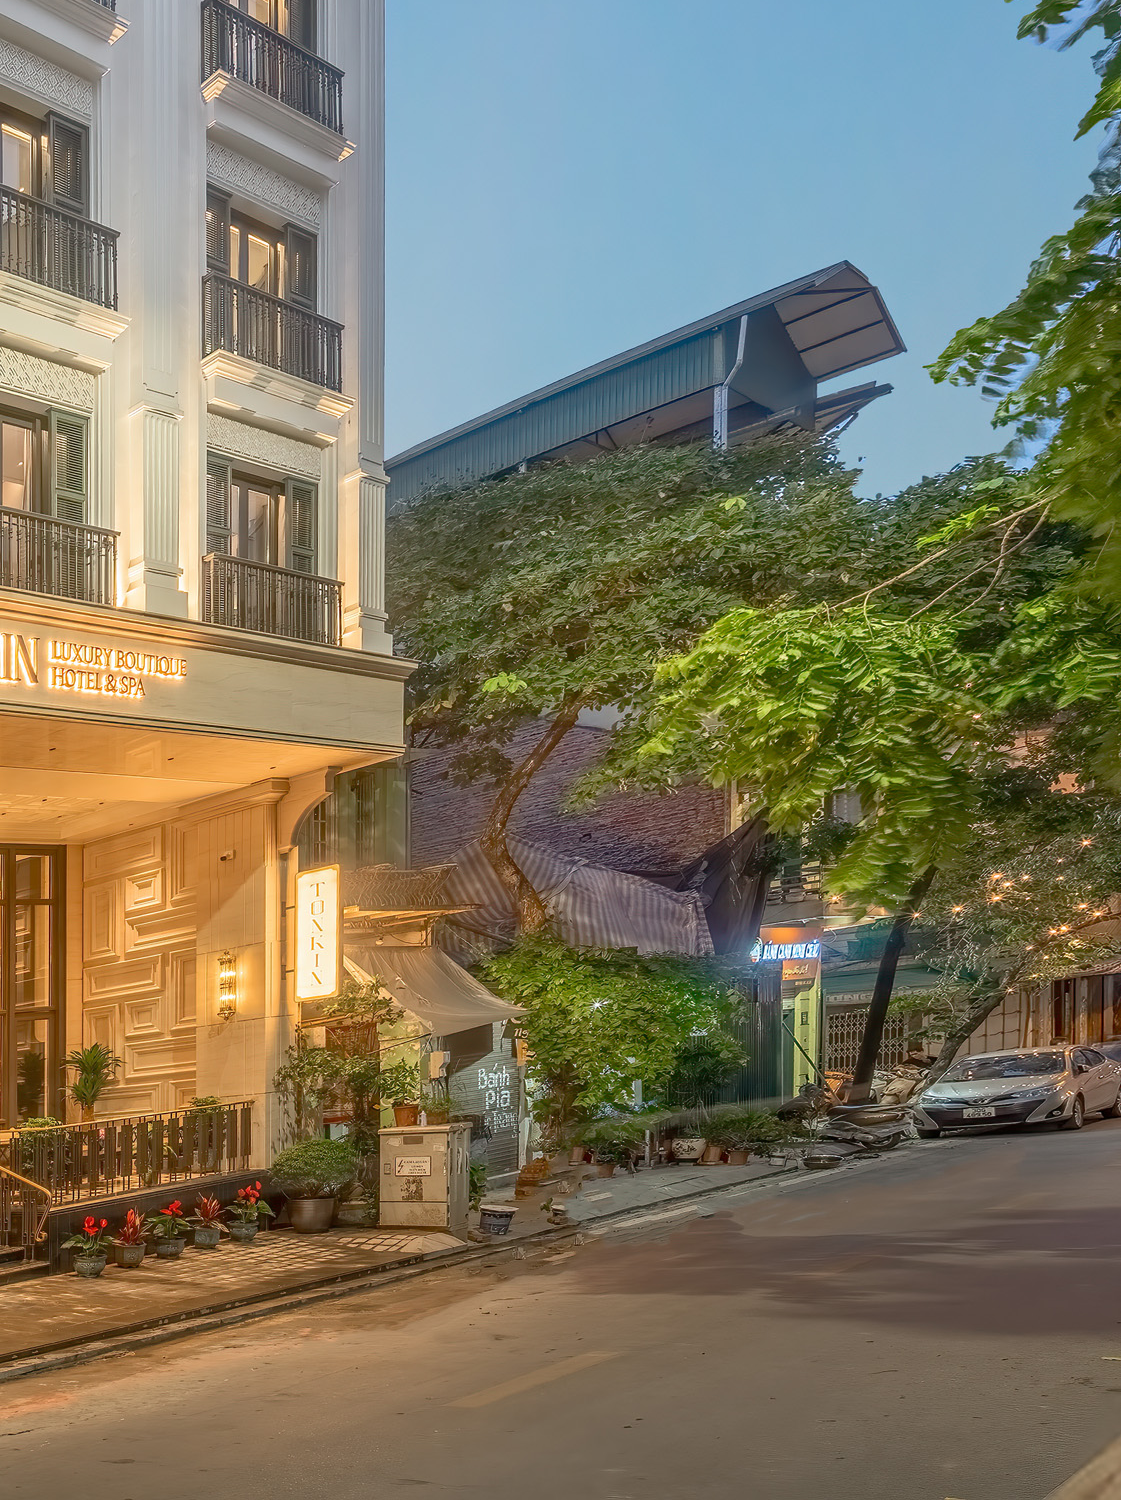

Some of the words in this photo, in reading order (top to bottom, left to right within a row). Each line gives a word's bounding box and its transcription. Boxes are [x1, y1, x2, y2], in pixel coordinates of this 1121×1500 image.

[50, 640, 113, 667] LUXURY
[114, 650, 188, 677] BOUTIQUE
[51, 667, 102, 691] HOTEL
[104, 674, 118, 693] &
[118, 675, 146, 696] SPA
[310, 881, 325, 986] TONKIN
[478, 1063, 511, 1090] Bánh
